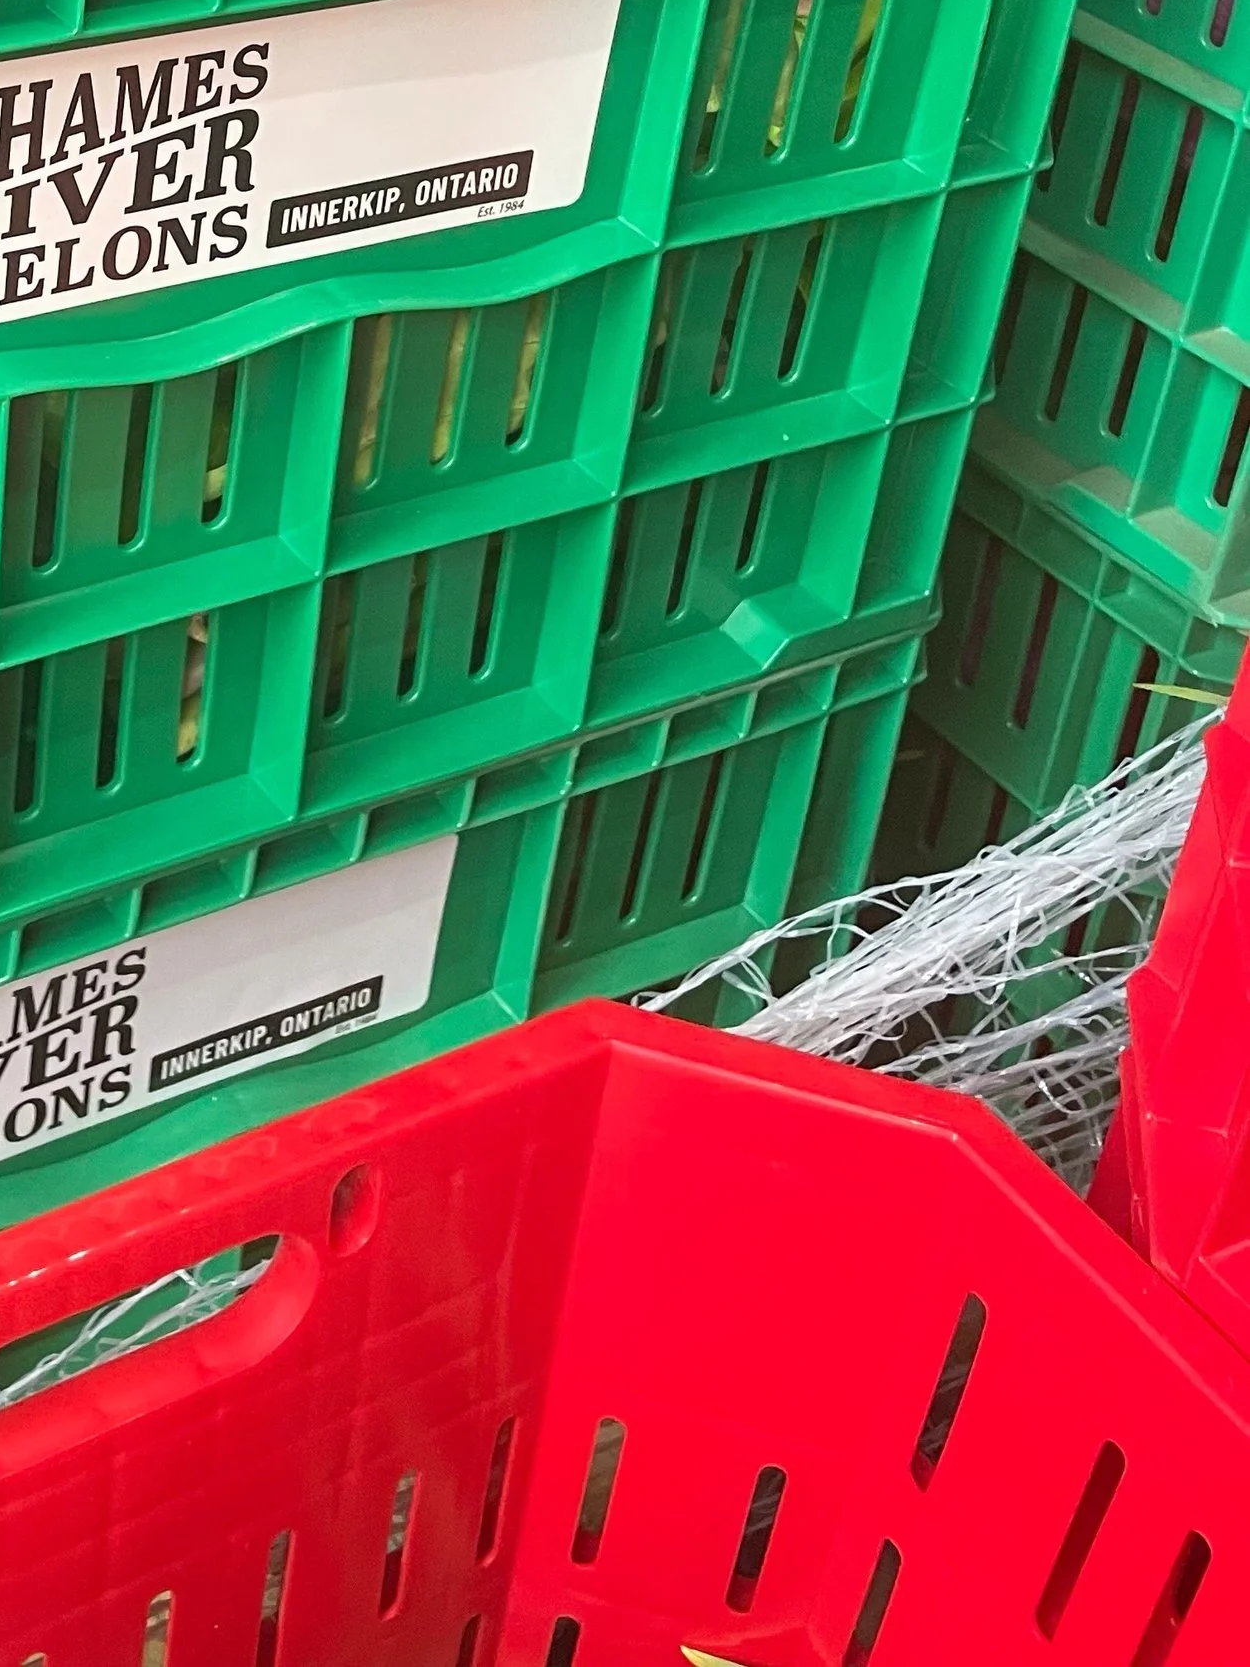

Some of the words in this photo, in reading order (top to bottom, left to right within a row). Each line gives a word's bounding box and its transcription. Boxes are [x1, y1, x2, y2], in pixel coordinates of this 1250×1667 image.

[280, 187, 406, 235] INNERKIP,
[414, 162, 519, 207] ONTARIO
[477, 205, 496, 219] Est.
[499, 199, 525, 214] 1984
[160, 1025, 273, 1081] INNERKIP,
[279, 987, 372, 1038] ONTARIO
